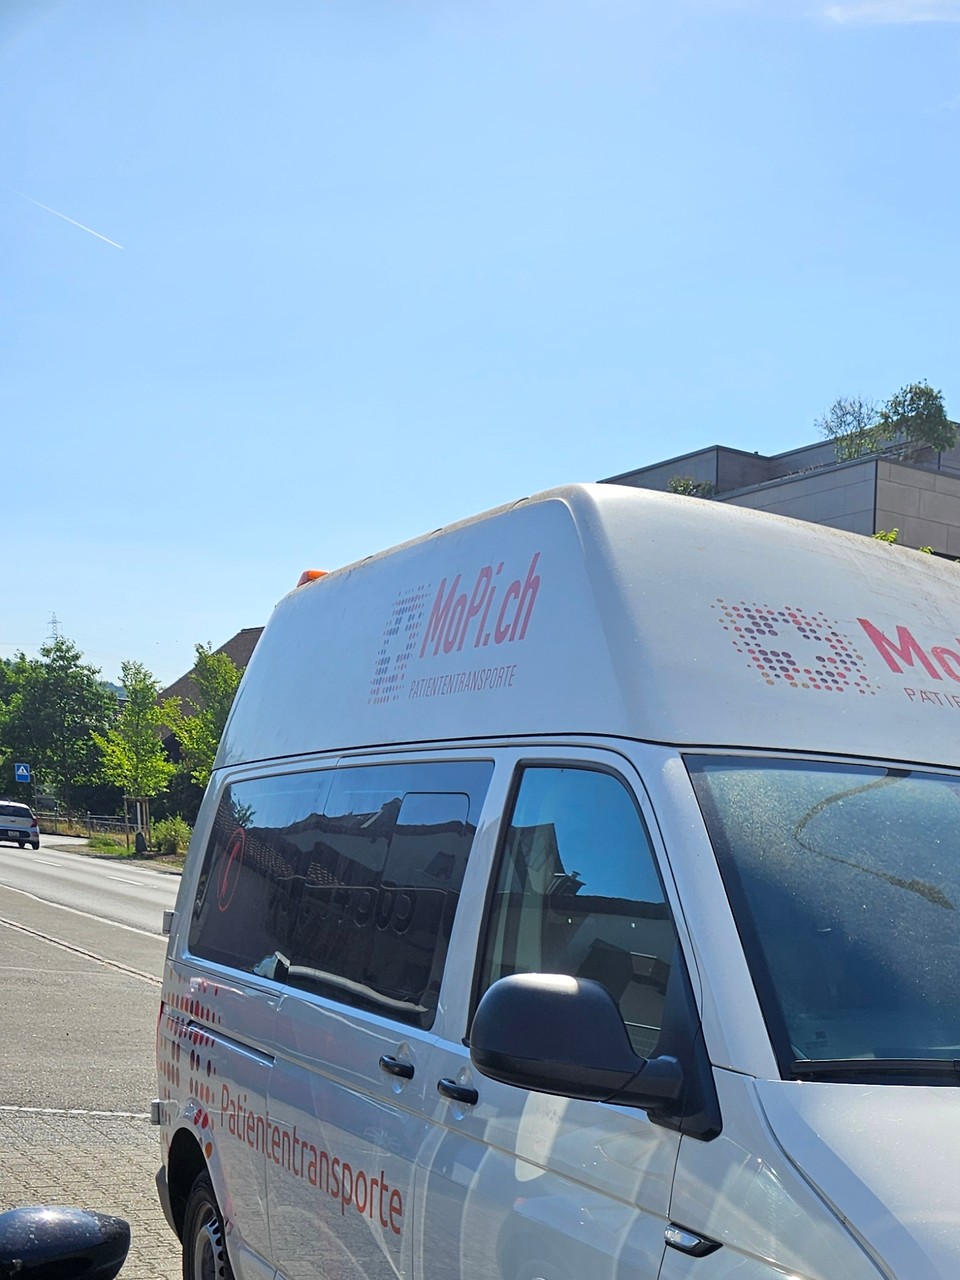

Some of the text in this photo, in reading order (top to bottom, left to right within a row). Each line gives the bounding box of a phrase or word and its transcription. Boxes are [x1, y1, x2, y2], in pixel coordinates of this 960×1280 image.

[419, 552, 541, 659] MoPi.ch
[408, 664, 517, 699] PATIENTENTRANSPORTE
[220, 1084, 403, 1235] Patiententransporte
